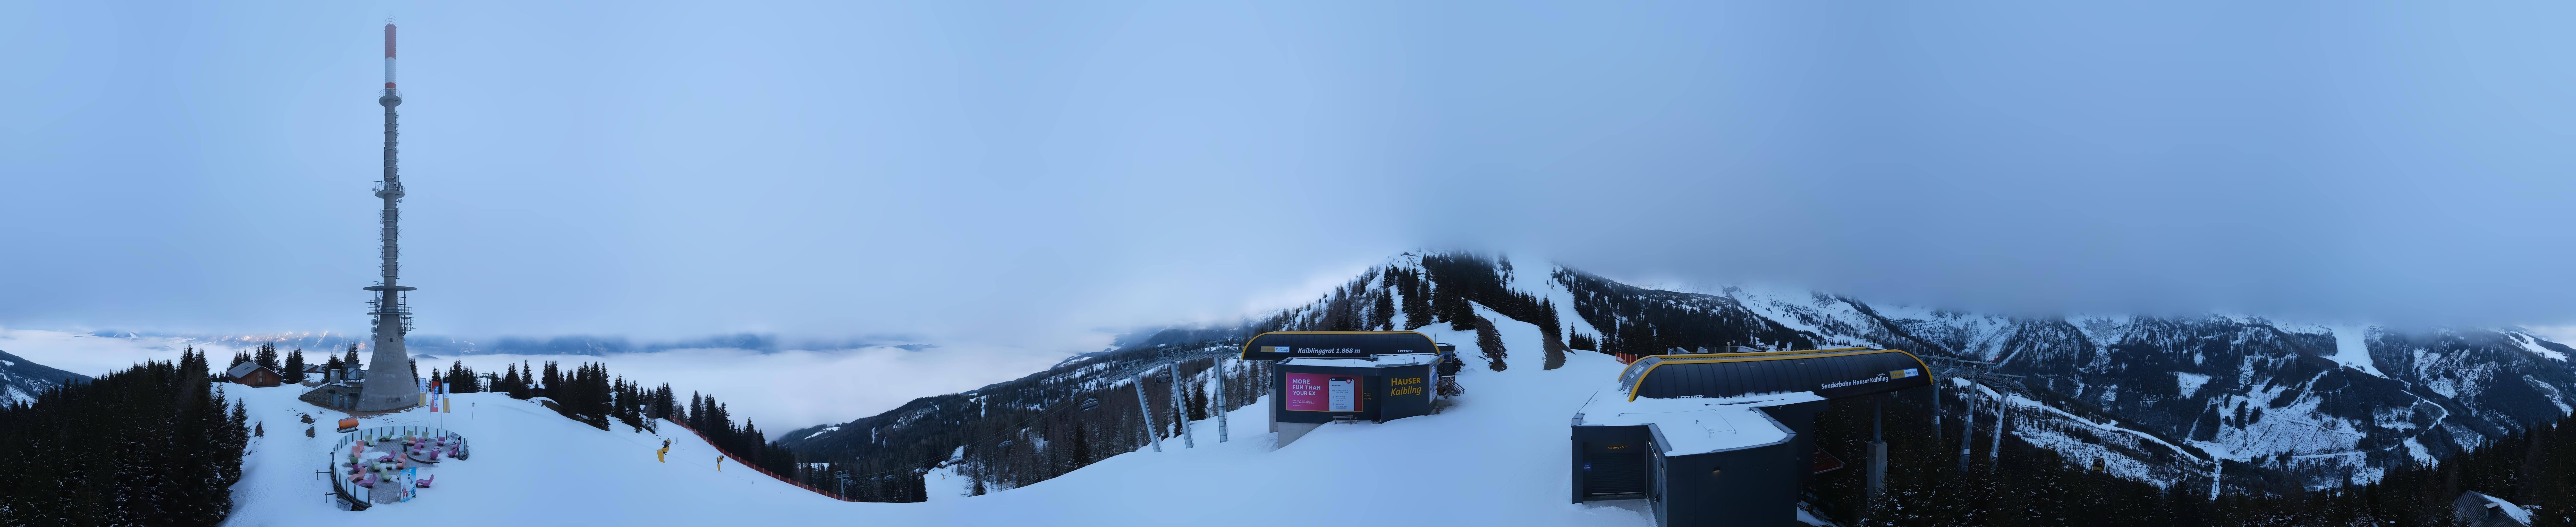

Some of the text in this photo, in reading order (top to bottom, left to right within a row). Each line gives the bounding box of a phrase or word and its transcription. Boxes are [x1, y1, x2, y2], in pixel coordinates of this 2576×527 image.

[1391, 377, 1421, 386] HAUSER
[1821, 380, 1852, 389] Senderbahn
[1391, 386, 1421, 396] Kaibling
